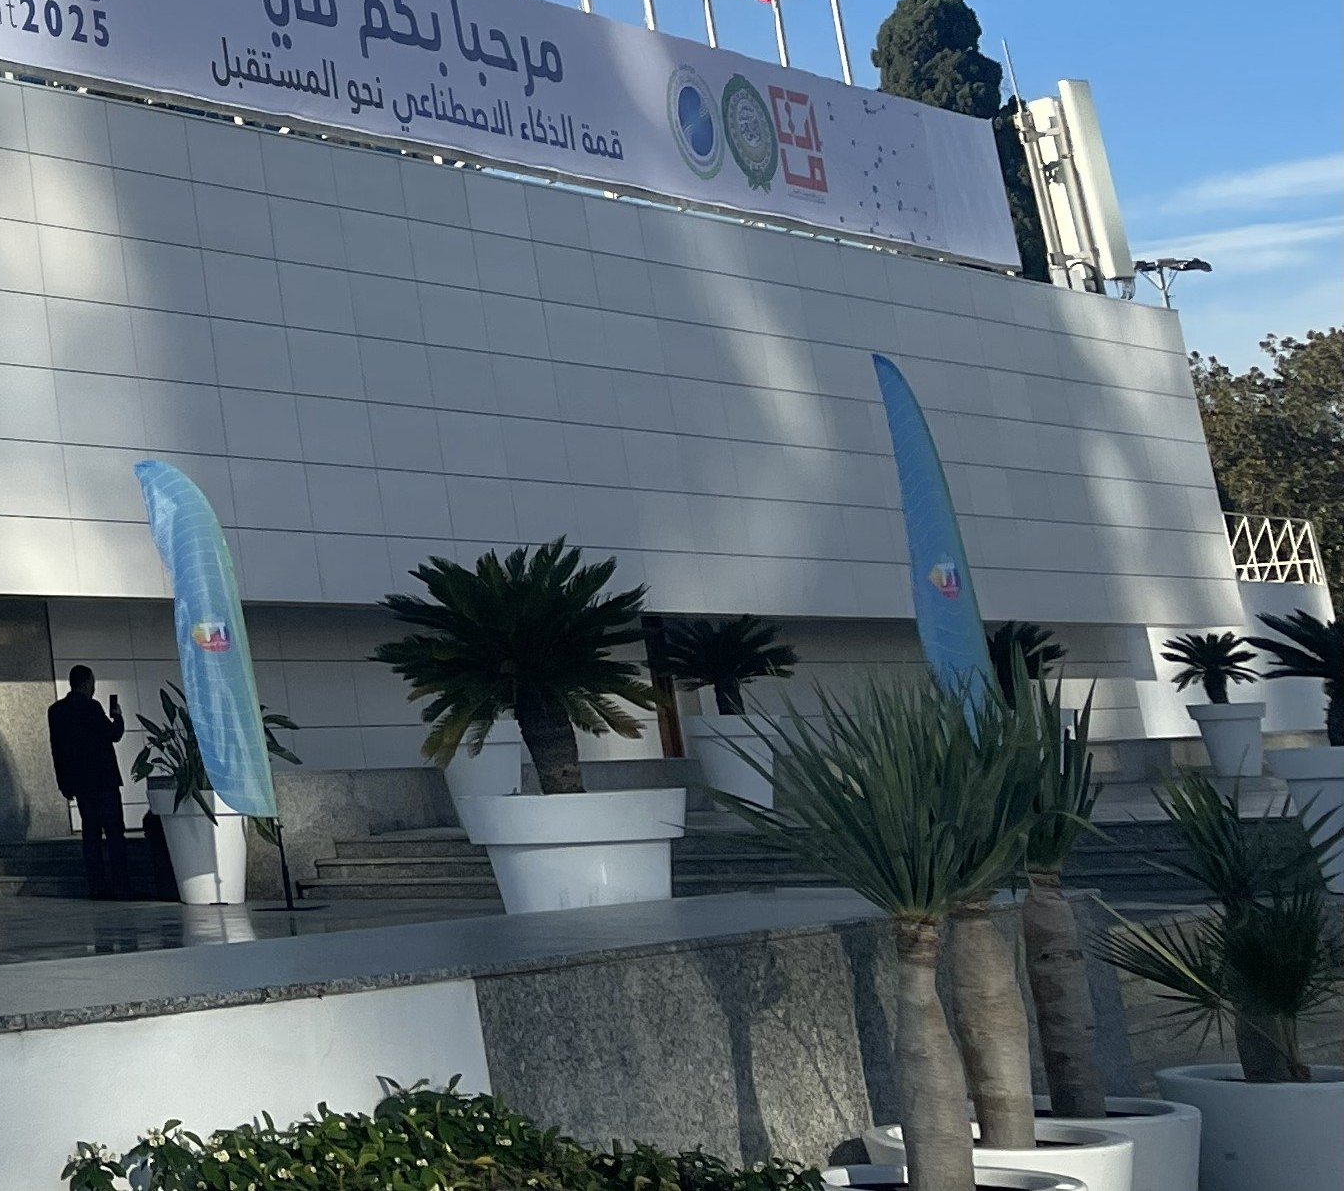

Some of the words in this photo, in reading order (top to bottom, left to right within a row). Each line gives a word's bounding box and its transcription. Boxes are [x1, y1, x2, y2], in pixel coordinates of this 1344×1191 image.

[212, 37, 339, 99] المستقبل
[347, 76, 385, 114] نحو
[393, 83, 513, 137] الاصطناعي
[520, 106, 576, 150] الذكاء
[582, 123, 624, 160] قمة
